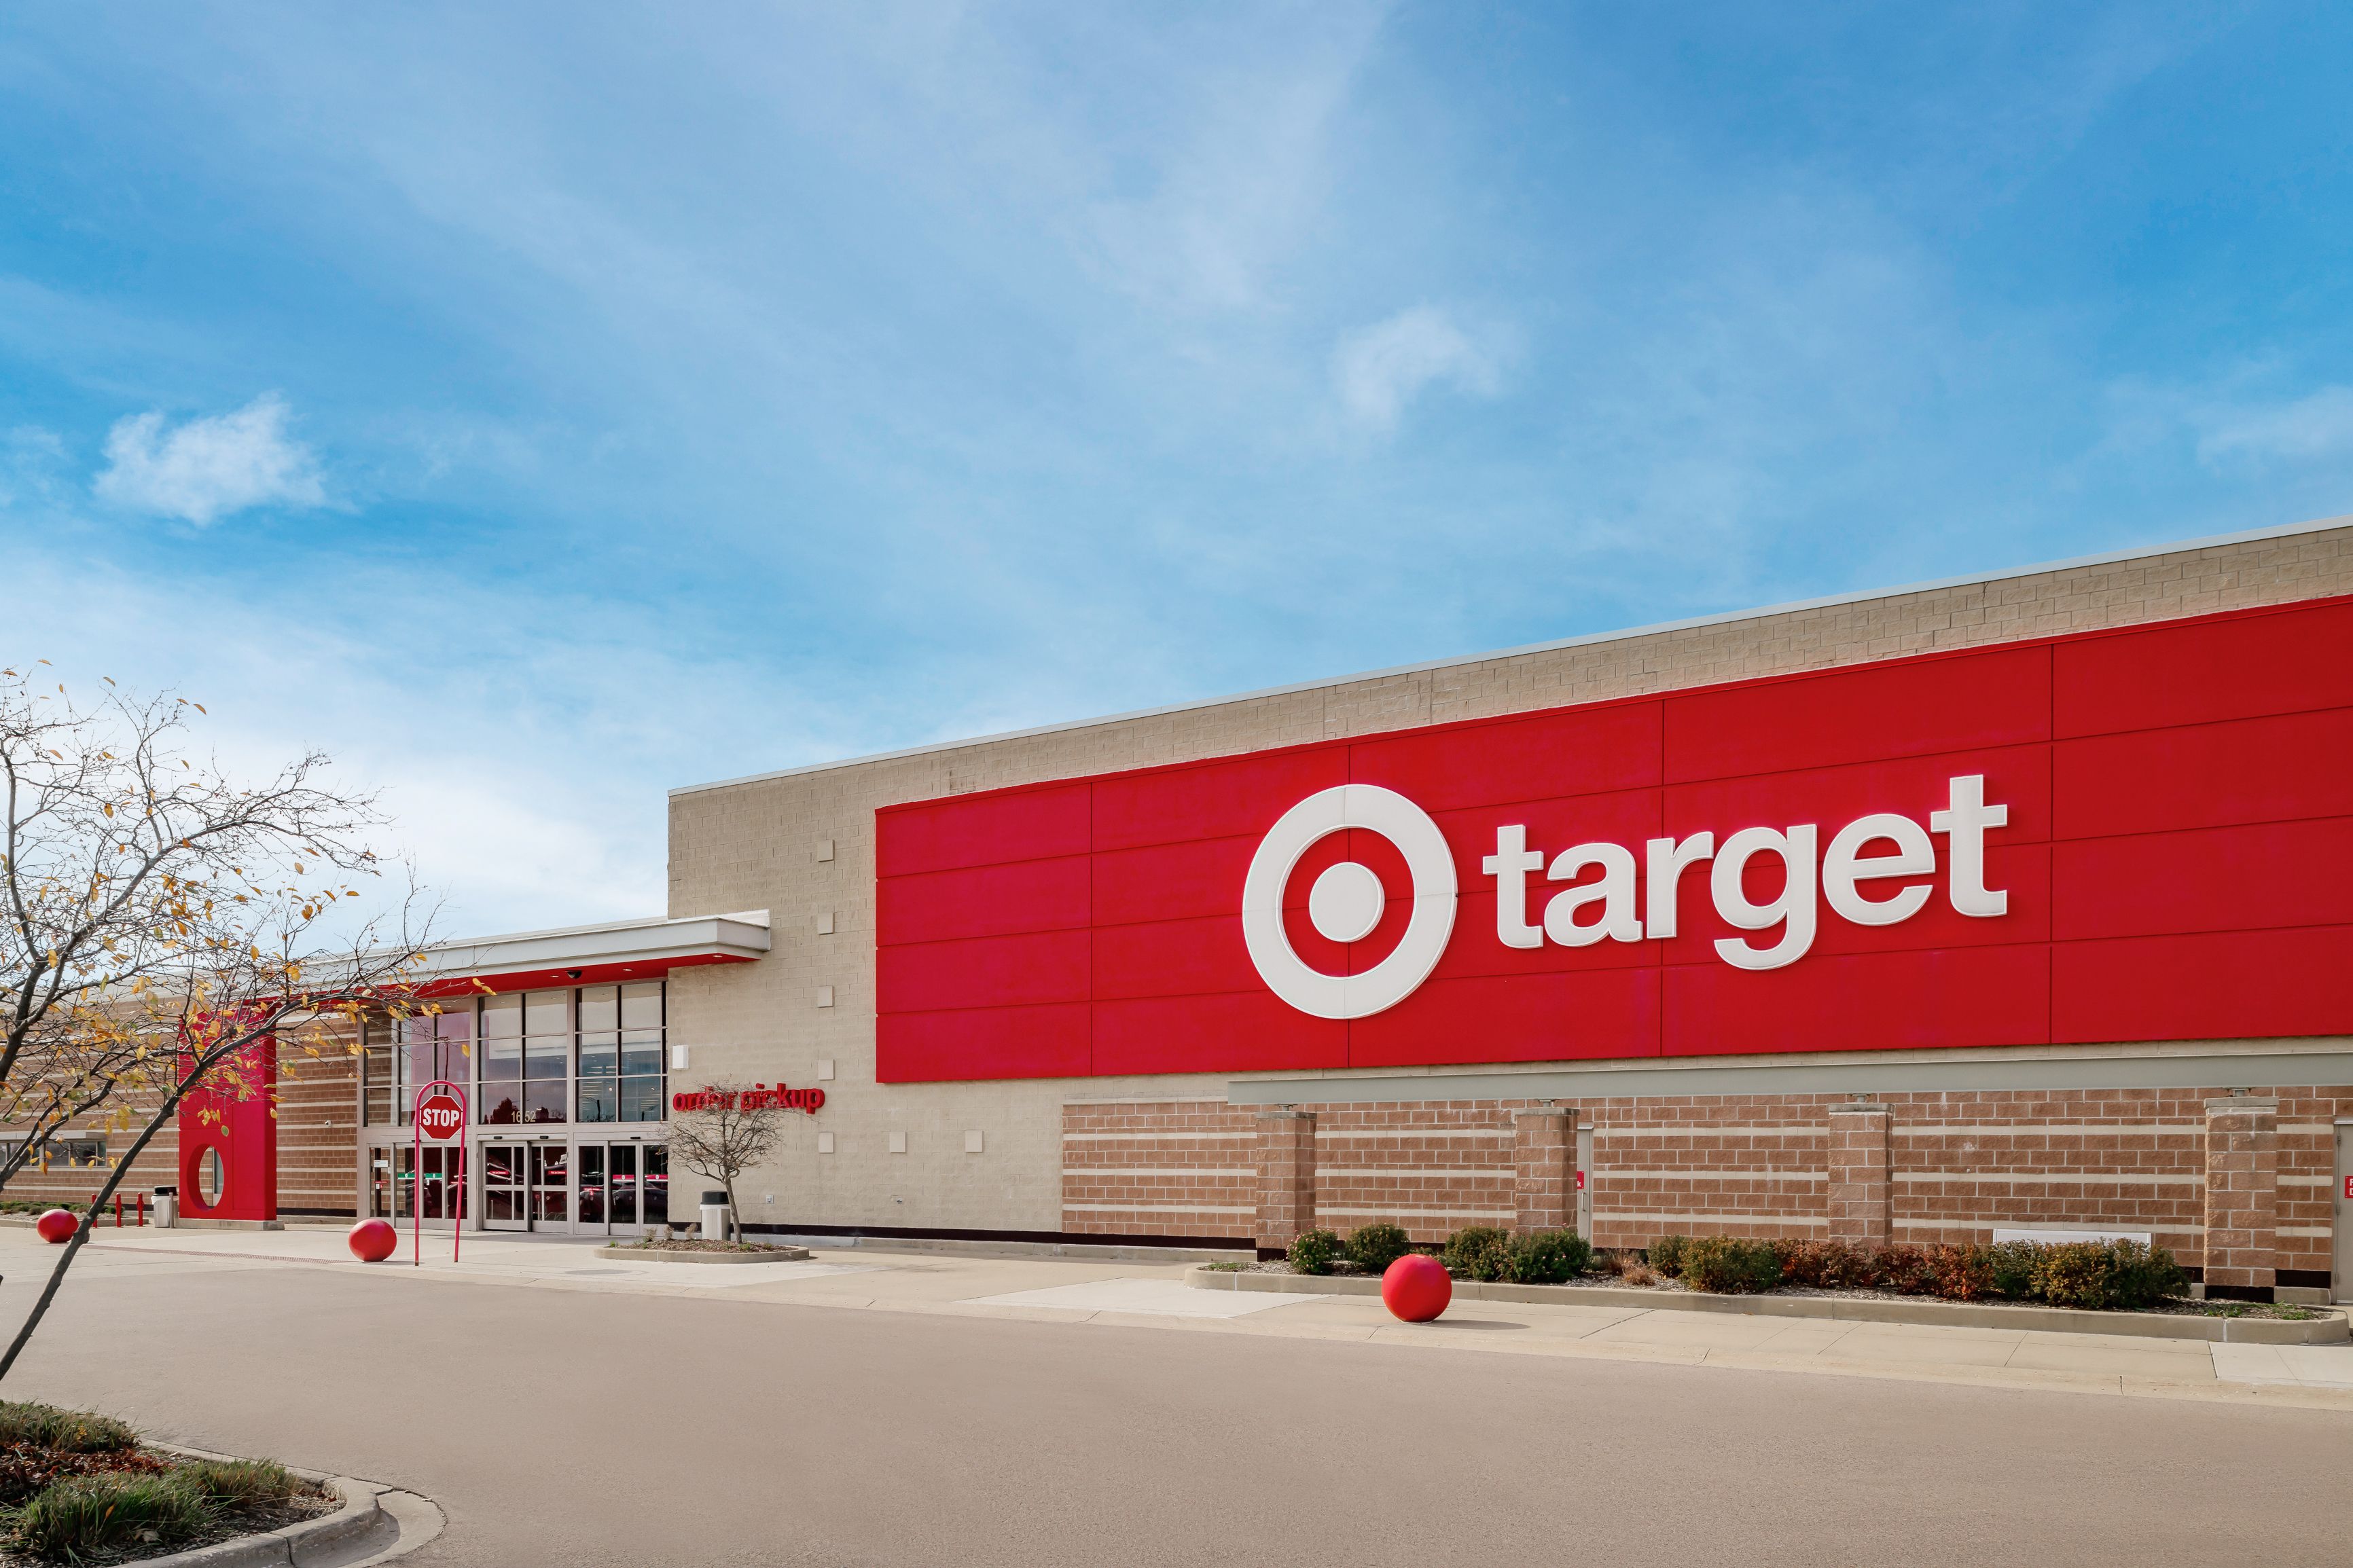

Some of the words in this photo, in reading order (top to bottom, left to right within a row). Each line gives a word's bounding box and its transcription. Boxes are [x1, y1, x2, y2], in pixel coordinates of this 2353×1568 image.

[1482, 773, 2009, 971] target
[740, 1082, 825, 1114] pickup
[423, 1108, 460, 1127] STOP
